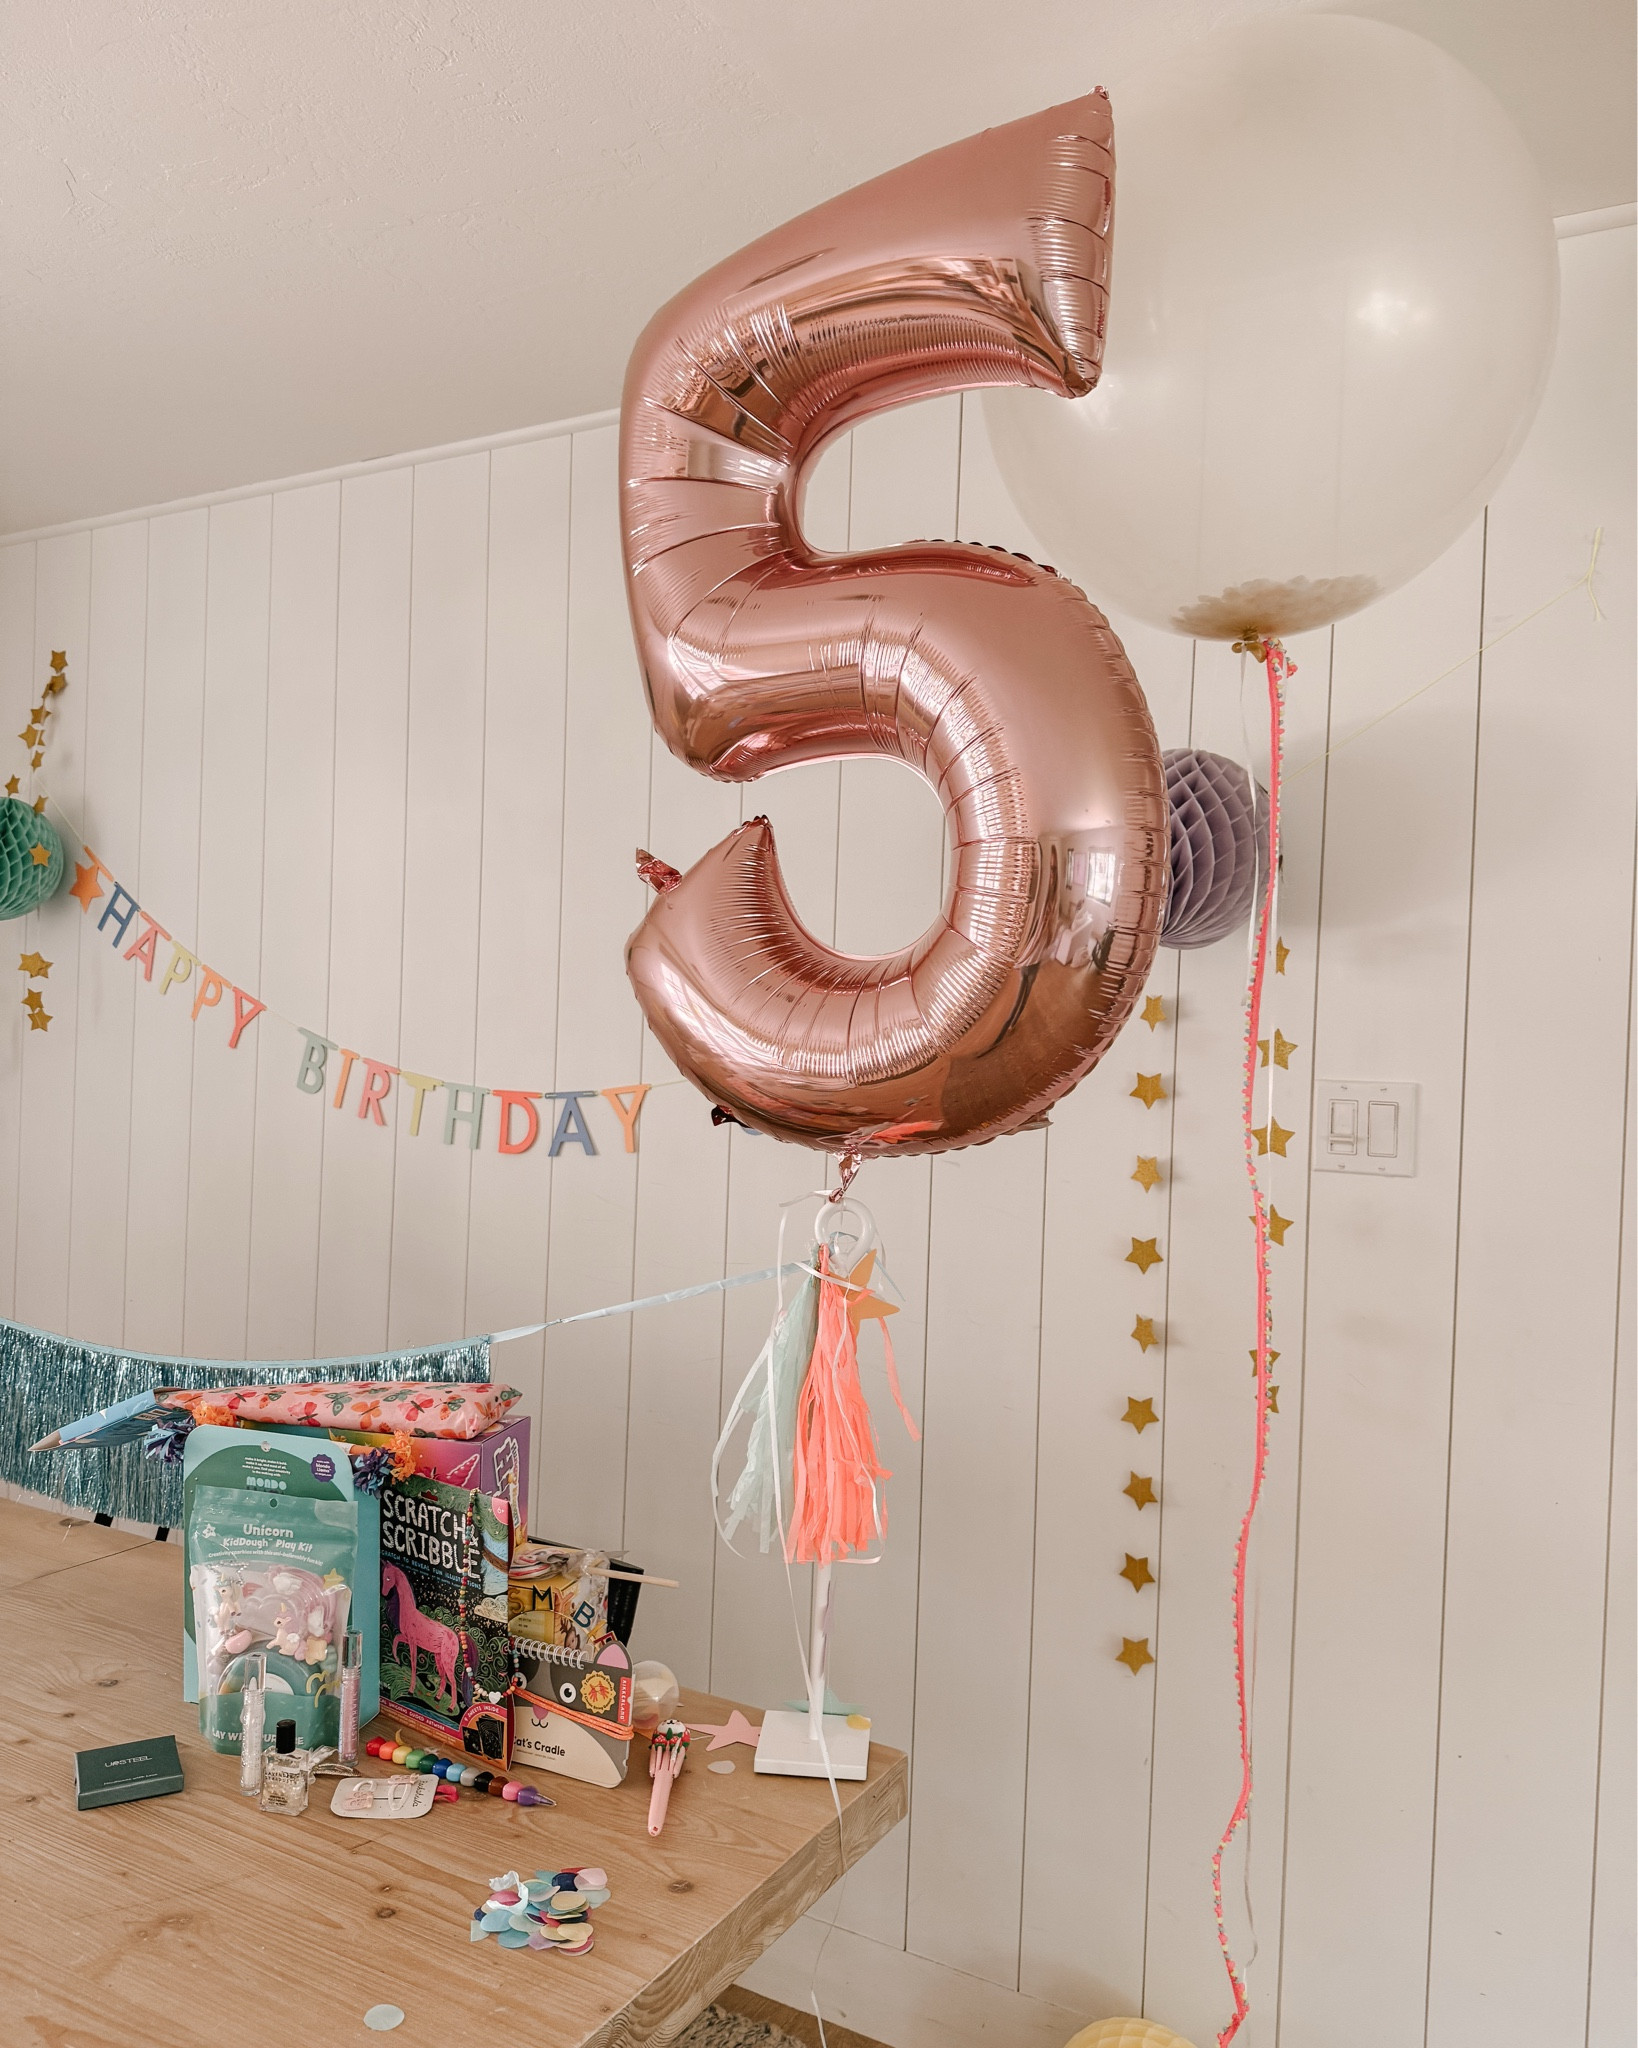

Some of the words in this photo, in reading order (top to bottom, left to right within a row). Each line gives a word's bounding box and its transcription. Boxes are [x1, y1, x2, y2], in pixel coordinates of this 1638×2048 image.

[97, 881, 267, 1049] HAPPY
[296, 1027, 652, 1157] BIRTHDAY
[243, 1523, 294, 1538] Unicorn
[383, 1489, 467, 1544] SCRATCH
[275, 1540, 296, 1552] Play
[298, 1542, 313, 1553] Kit
[383, 1521, 481, 1579] SCRIBBLE
[534, 1740, 566, 1756] Cradle
